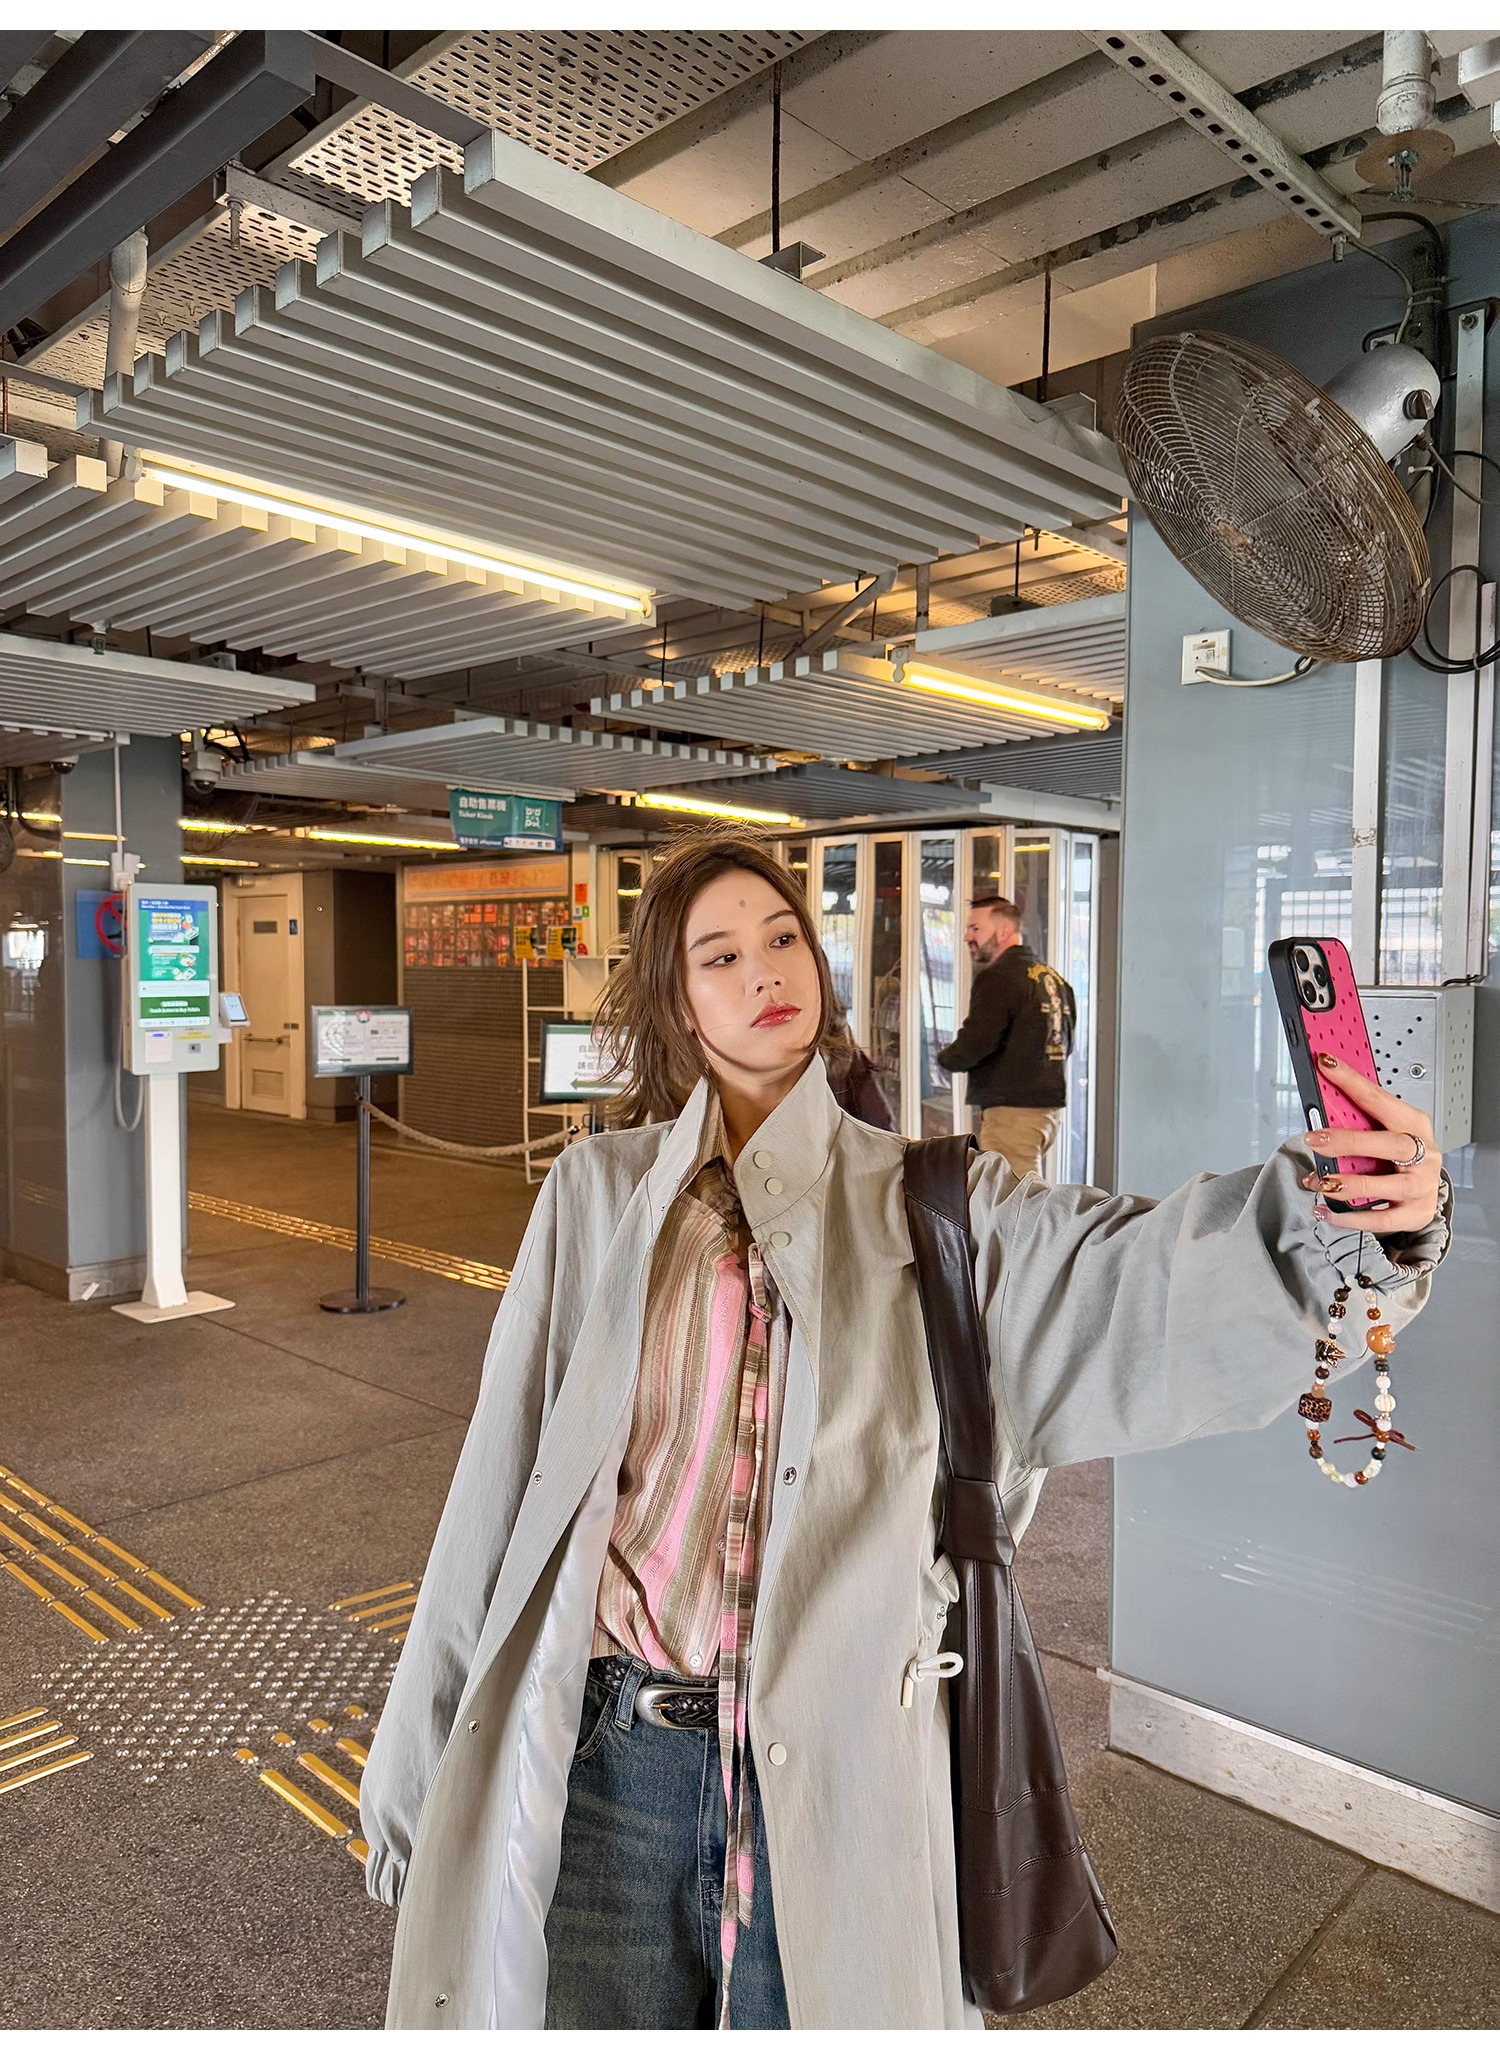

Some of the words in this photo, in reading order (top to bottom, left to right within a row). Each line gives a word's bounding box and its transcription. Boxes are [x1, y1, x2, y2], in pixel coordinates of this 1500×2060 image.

[459, 796, 506, 811] 自助售票機
[458, 810, 476, 818] Ticket
[477, 812, 494, 820] Kiosk
